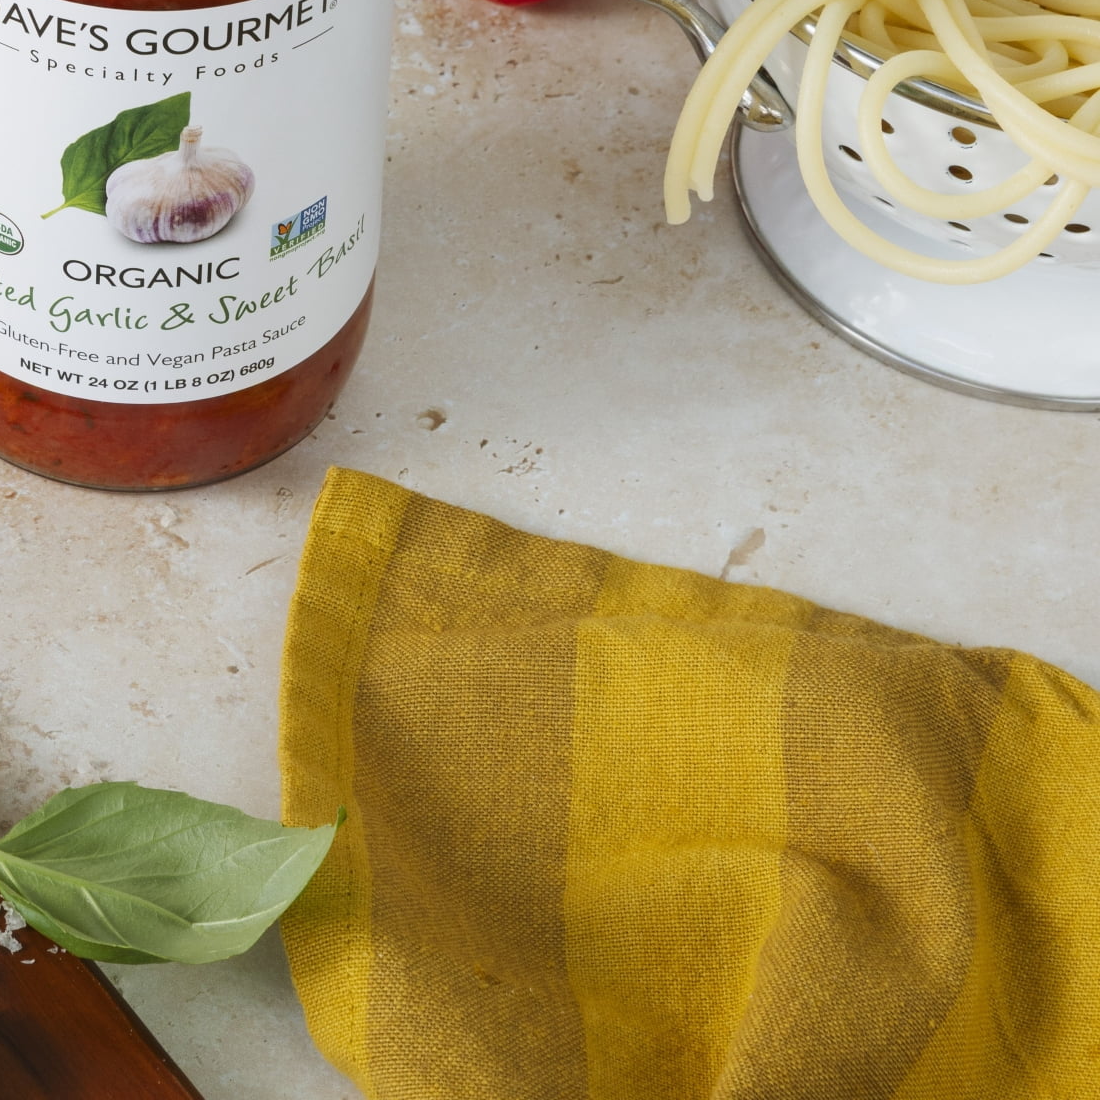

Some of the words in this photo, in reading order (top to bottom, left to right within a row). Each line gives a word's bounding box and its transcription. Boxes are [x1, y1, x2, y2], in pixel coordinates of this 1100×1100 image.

[30, 49, 172, 85] Specialty
[196, 52, 278, 80] Foods
[302, 207, 325, 225] GMO
[302, 215, 325, 231] Project
[303, 199, 325, 217] NON
[274, 222, 324, 254] VERIFIED
[49, 296, 148, 332] Garlic
[160, 303, 195, 331] &
[208, 276, 298, 324] Sweet
[306, 213, 365, 279] Basil
[62, 257, 240, 289] ORGANIC
[105, 353, 140, 366] and
[147, 353, 205, 369] Vegan
[211, 339, 257, 360] Pasta
[262, 315, 306, 345] Sauce
[20, 357, 52, 377] NET
[57, 369, 84, 385] WT
[88, 376, 108, 389] 24
[113, 379, 139, 391] OZ
[144, 380, 157, 393] (1
[164, 378, 187, 390] LB
[192, 376, 202, 387] 8
[206, 369, 235, 385] OZ)
[239, 356, 275, 377] 680g
